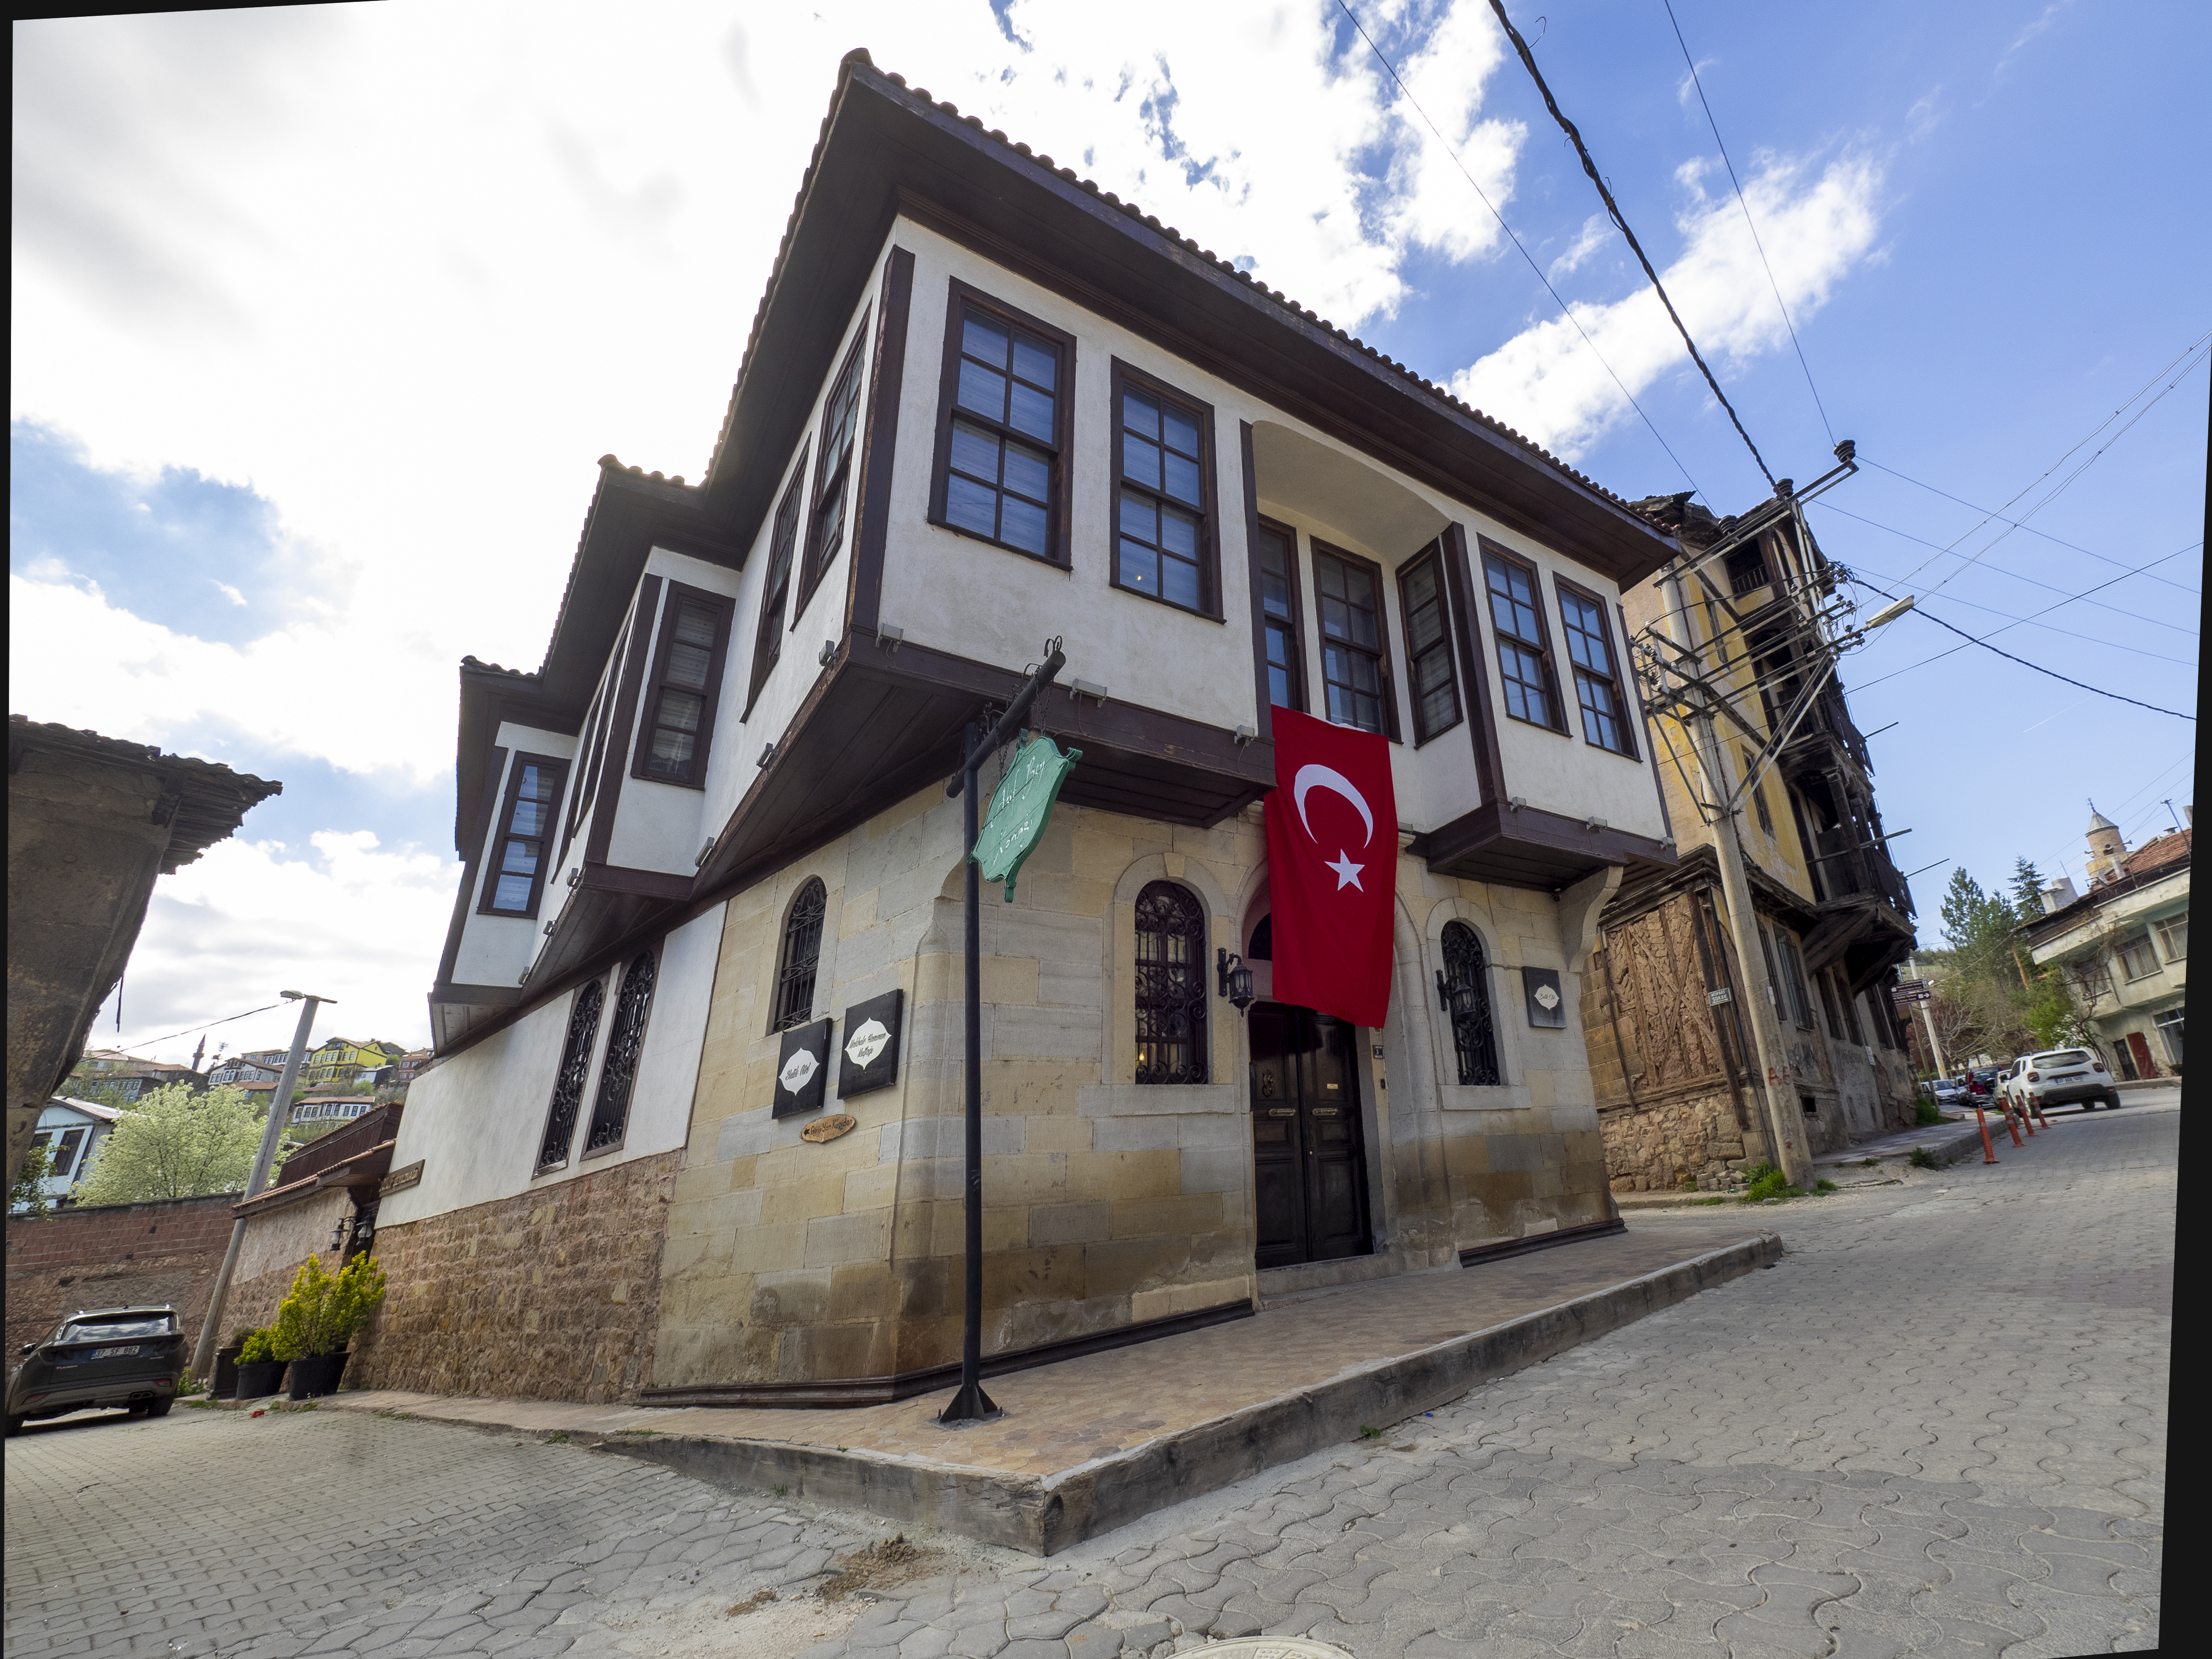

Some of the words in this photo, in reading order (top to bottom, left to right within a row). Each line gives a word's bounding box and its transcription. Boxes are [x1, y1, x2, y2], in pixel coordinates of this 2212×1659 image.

[1022, 755, 1046, 800] Bey
[785, 1065, 799, 1081] Butik
[800, 1061, 811, 1076] Otel
[822, 1122, 831, 1132] Yan
